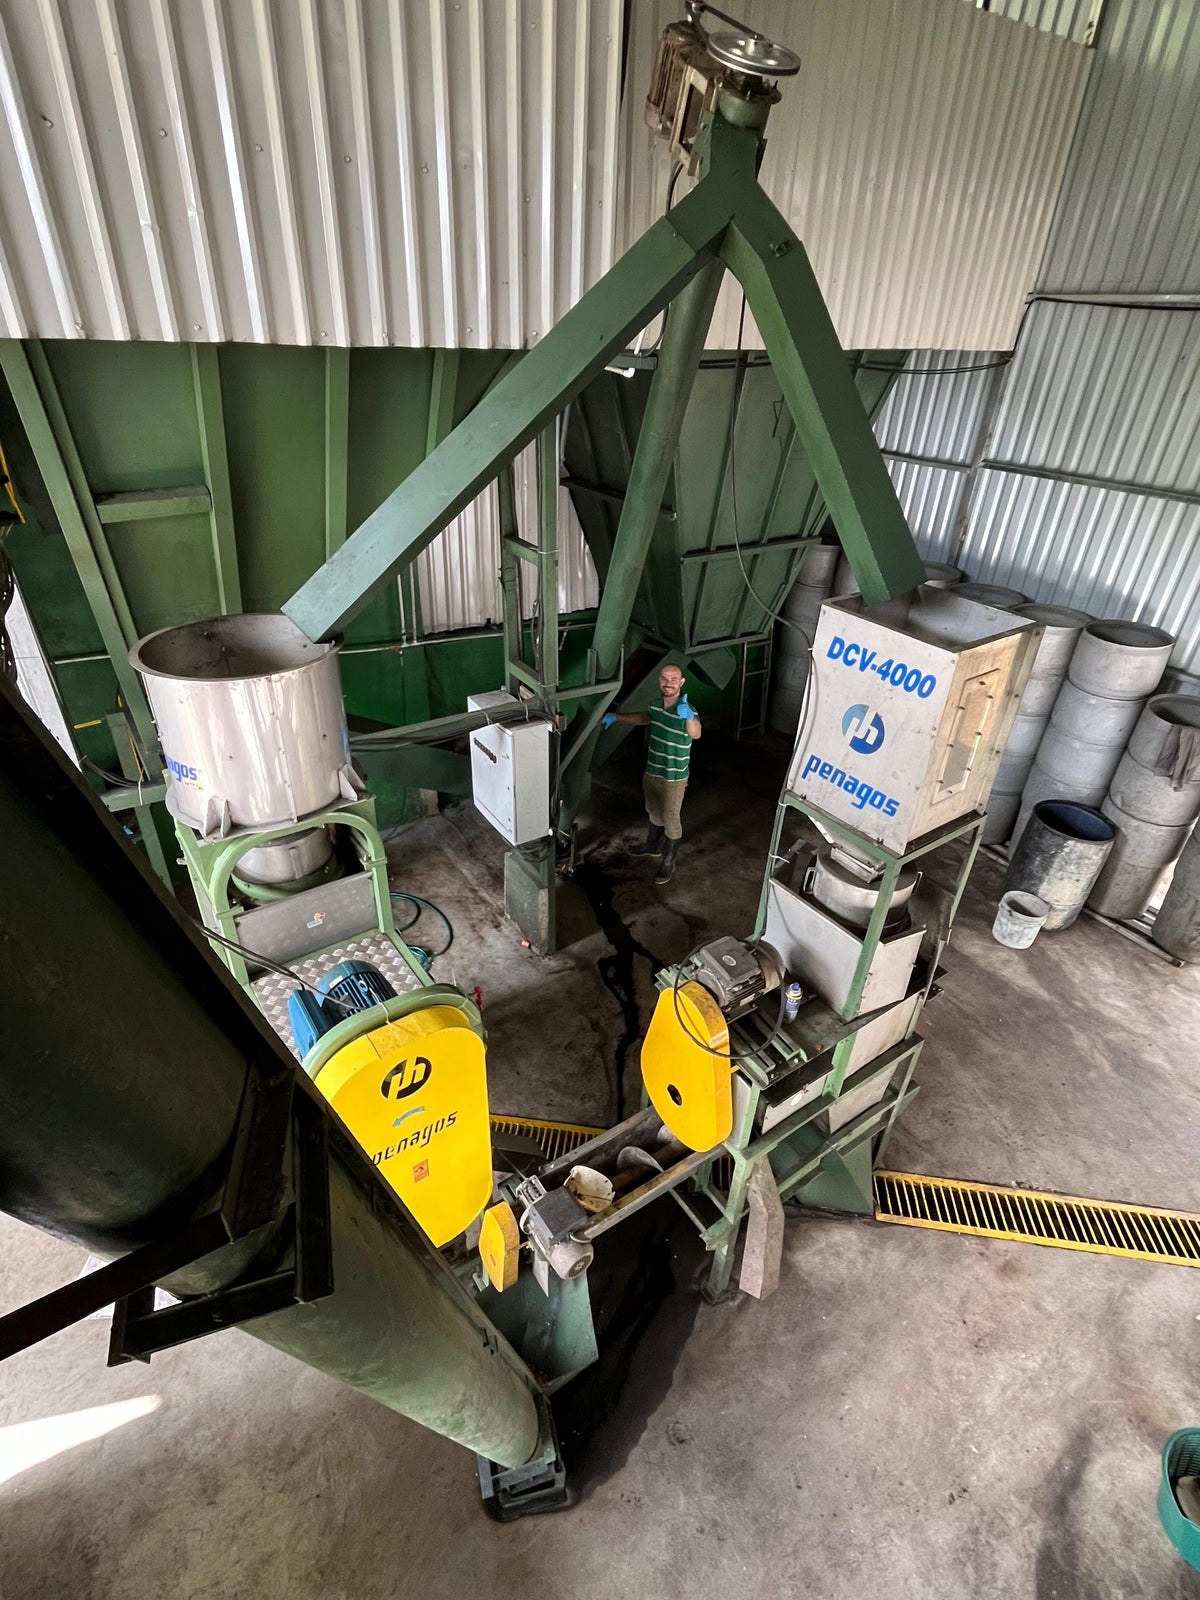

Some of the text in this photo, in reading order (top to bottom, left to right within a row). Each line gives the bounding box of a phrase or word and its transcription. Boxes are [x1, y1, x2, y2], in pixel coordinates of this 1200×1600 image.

[826, 636, 937, 699] DCV-4000
[164, 754, 198, 782] agos
[801, 754, 901, 817] penagos
